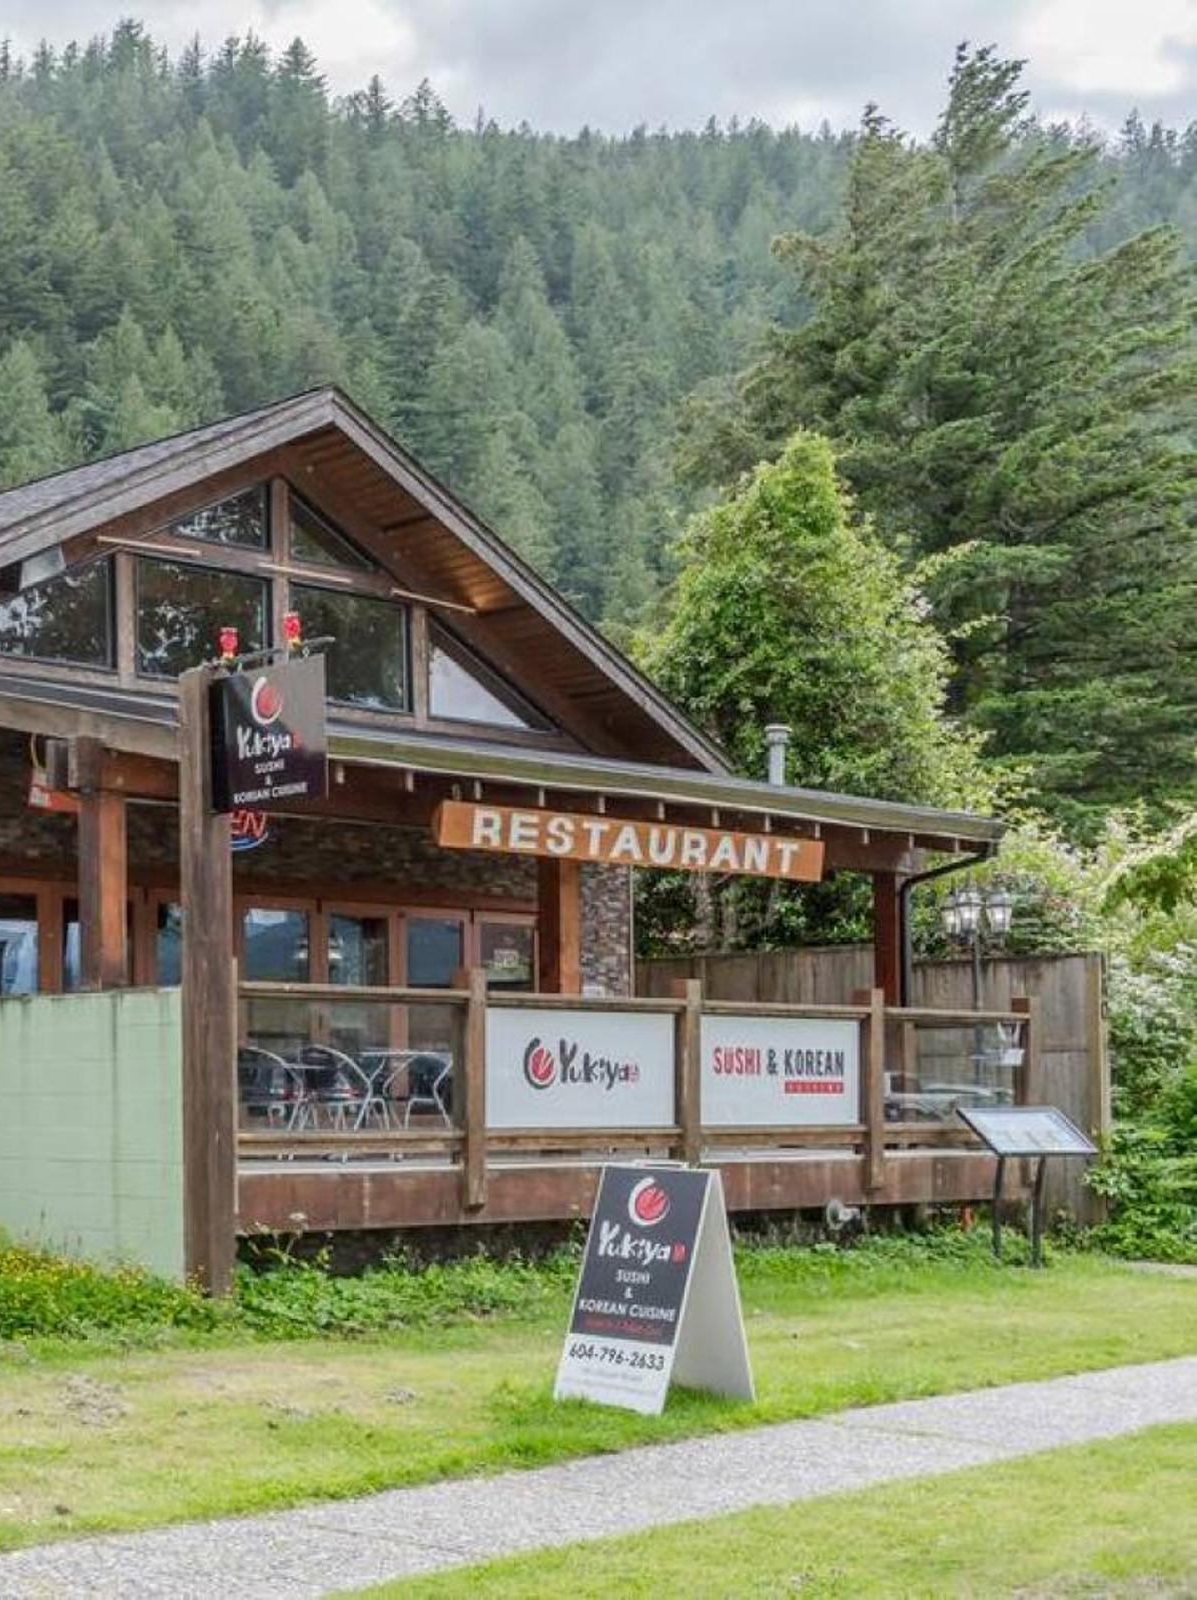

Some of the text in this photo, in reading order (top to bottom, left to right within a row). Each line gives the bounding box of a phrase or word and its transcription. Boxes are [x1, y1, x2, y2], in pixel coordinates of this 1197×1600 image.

[236, 726, 291, 760] Yukiya
[255, 760, 284, 773] SUSHI
[234, 783, 307, 803] KOREAN CUISINE
[265, 775, 272, 785] &
[471, 806, 802, 874] RESTAURANT
[559, 1038, 630, 1091] Yukiya
[712, 1046, 845, 1077] SUSHI & KOREAN
[598, 1220, 671, 1265] Yukiya
[615, 1269, 651, 1284] SUSHI
[623, 1286, 634, 1299] &
[578, 1299, 677, 1322] KOREAN CUISINE
[568, 1342, 666, 1372] 604-796-2633
